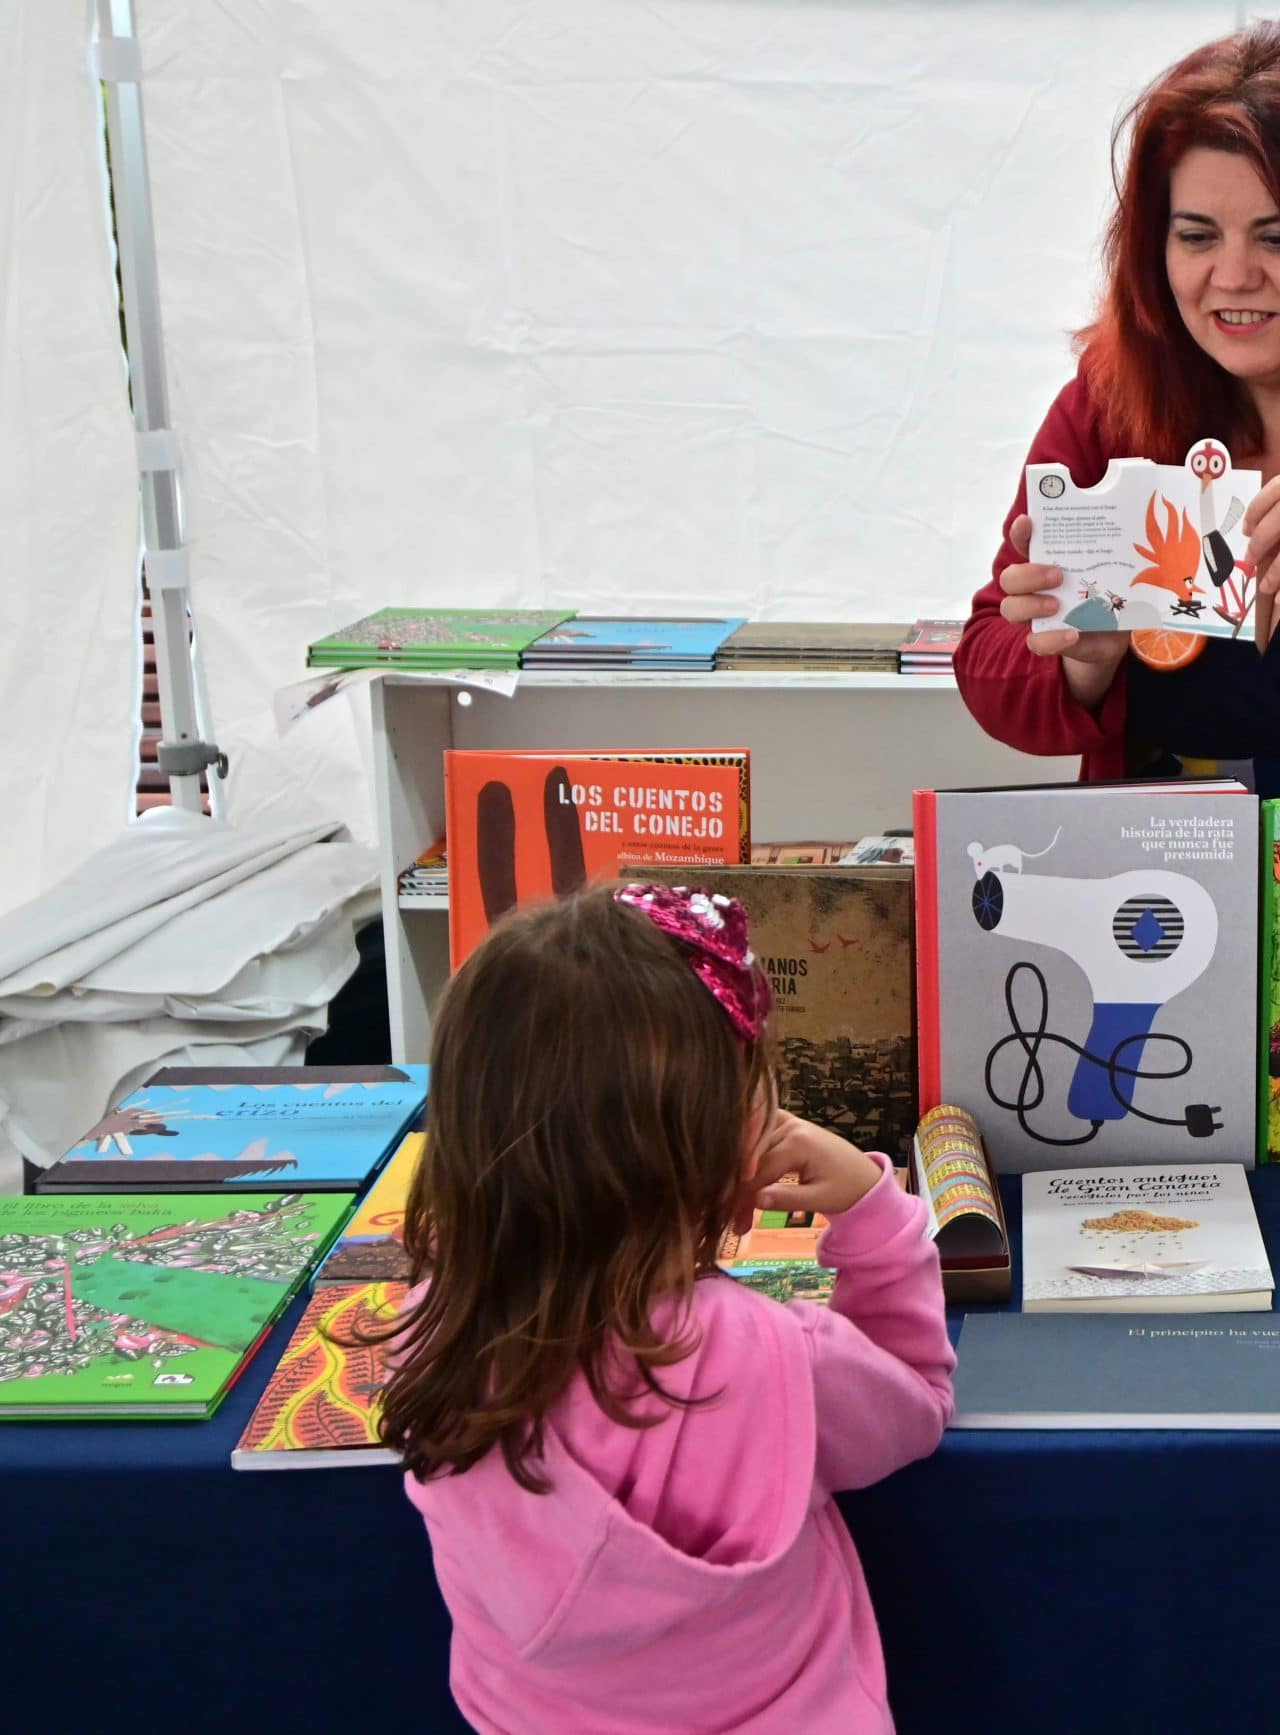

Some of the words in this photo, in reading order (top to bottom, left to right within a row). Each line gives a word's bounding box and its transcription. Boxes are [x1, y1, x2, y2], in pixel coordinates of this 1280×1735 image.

[558, 783, 603, 807] LOS
[613, 786, 724, 813] CUENTOS
[585, 811, 624, 834] DEL
[633, 814, 724, 839] CONEJO
[1150, 816, 1167, 828] La
[1169, 816, 1234, 828] verdadera
[1121, 826, 1173, 839] historia
[1174, 827, 1191, 838] de
[1193, 827, 1205, 838] la
[1207, 828, 1234, 839] rata
[1141, 840, 1166, 852] que
[1168, 840, 1209, 849] nunca
[1211, 837, 1234, 849] fue
[642, 853, 653, 862] de
[655, 851, 725, 866] Mozambique
[1164, 848, 1234, 863] presumida
[215, 1108, 301, 1117] erizo
[1049, 1177, 1124, 1187] Cuentos
[1132, 1174, 1218, 1184] antiguos
[1047, 1184, 1069, 1195] de
[1077, 1185, 1130, 1194] Gran
[1138, 1182, 1221, 1191] Canaria
[1128, 1328, 1146, 1337] El
[1150, 1328, 1225, 1339] principito
[1228, 1328, 1247, 1337] ha
